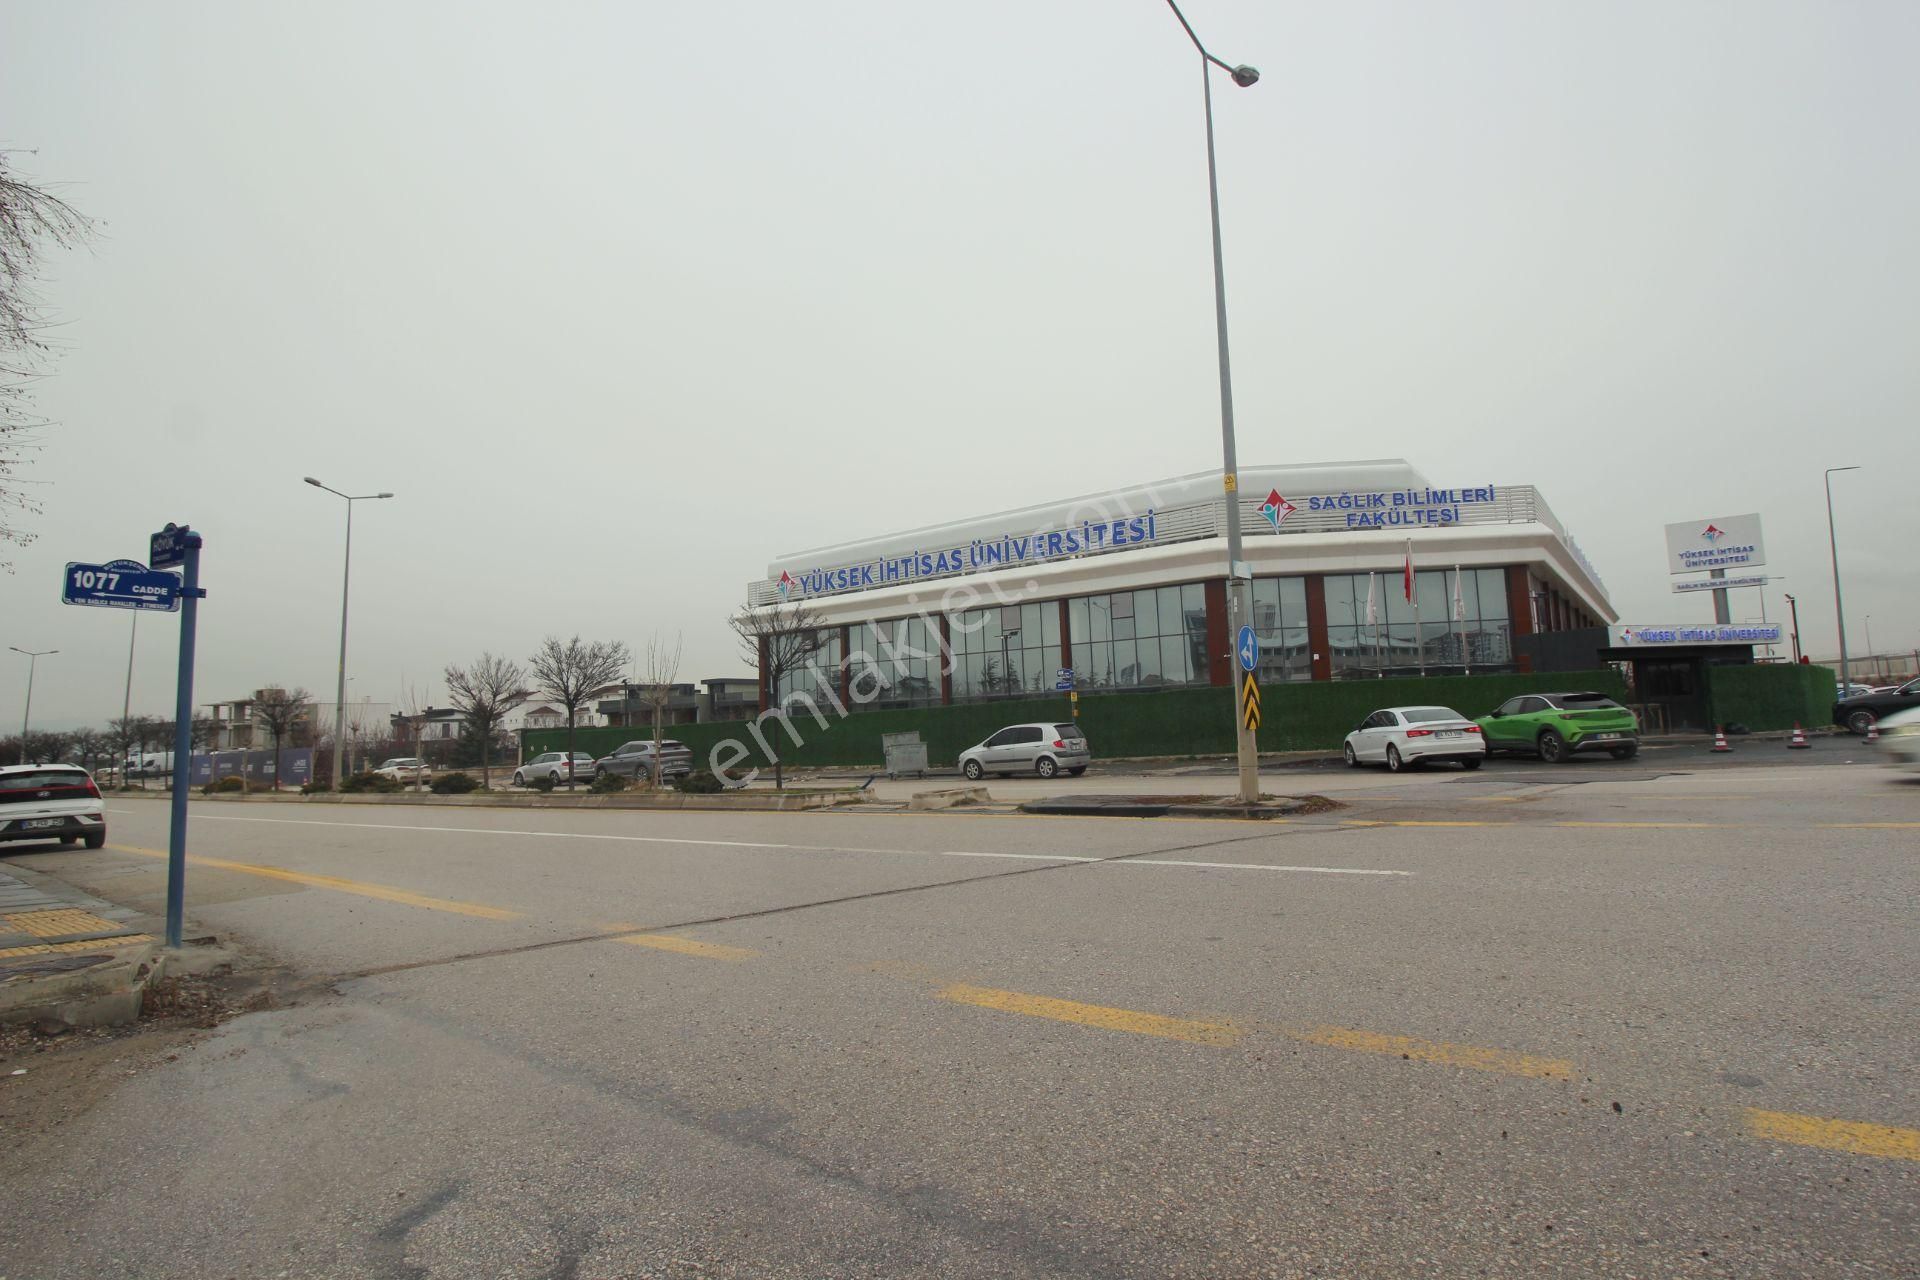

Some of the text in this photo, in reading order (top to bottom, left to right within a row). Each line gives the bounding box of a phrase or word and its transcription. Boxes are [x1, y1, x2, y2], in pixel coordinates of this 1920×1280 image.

[1309, 484, 1495, 510] SAĞLIK BİLİMLERİ
[1346, 504, 1460, 526] FAKÜLTESİ
[800, 509, 1155, 594] YÜKSEK İHTİSAS ÜNİVERSİTESİ
[1678, 545, 1755, 560] YÜKSEK İHTİSAS
[1685, 554, 1749, 568] ÜNİVERSİTESİ
[74, 570, 168, 596] 1077 CADDE
[1638, 627, 1677, 641] YÜKSEK
